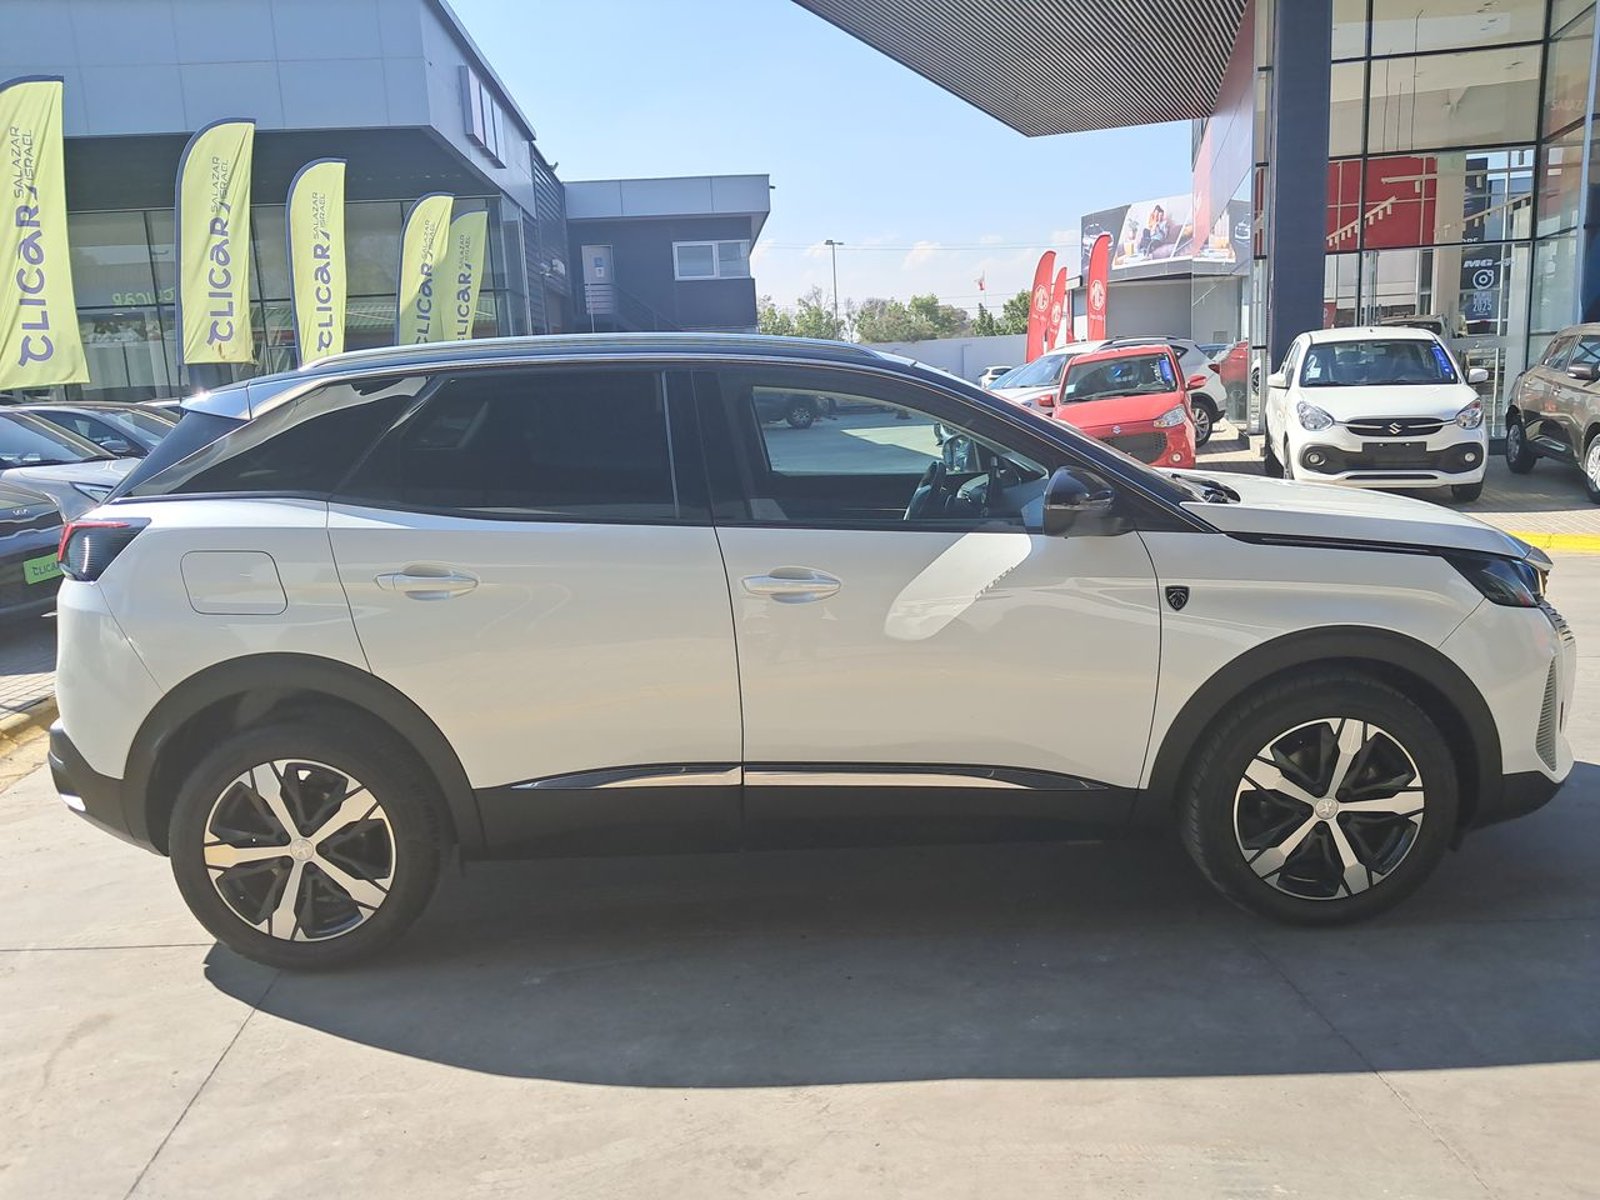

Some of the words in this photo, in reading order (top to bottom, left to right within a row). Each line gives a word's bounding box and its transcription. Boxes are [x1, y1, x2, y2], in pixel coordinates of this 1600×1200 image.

[9, 125, 22, 199] SALAZAR
[22, 129, 34, 182] ISRAEL
[220, 159, 229, 203] ISRAEL
[210, 156, 220, 213] SALAZAR
